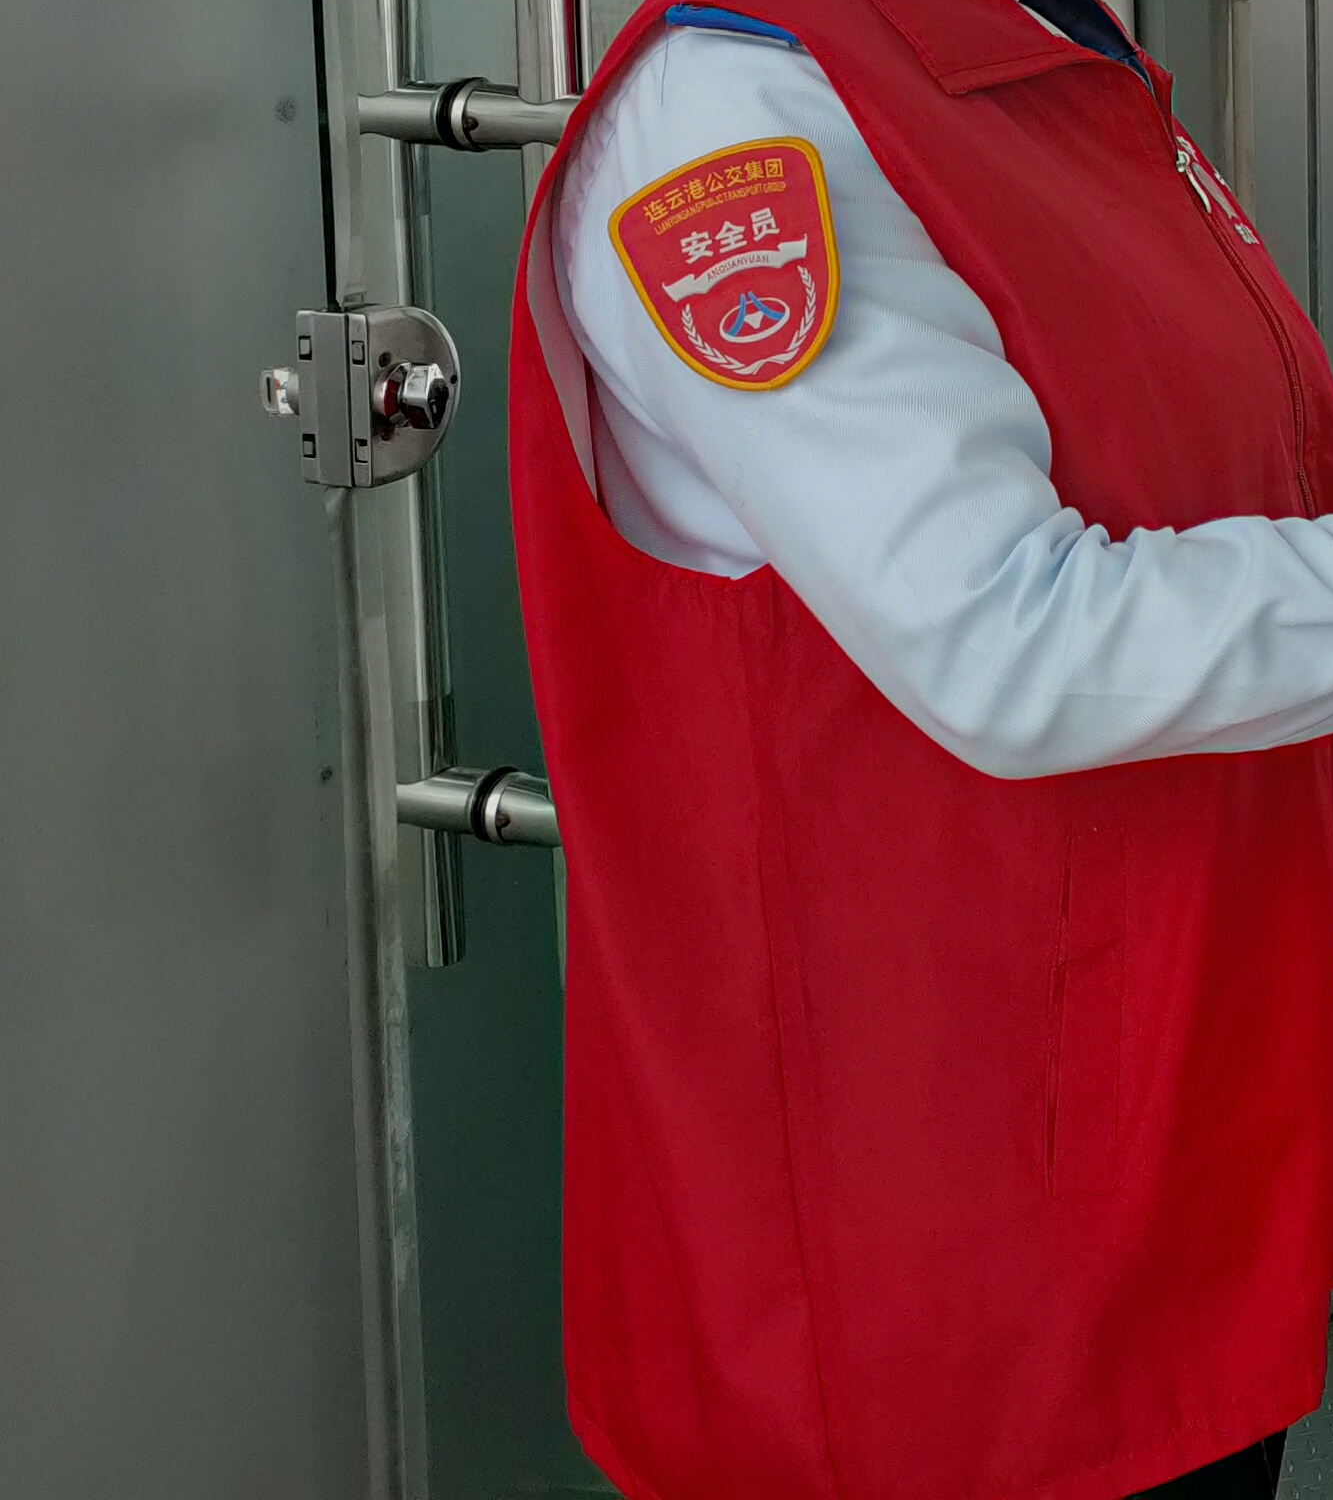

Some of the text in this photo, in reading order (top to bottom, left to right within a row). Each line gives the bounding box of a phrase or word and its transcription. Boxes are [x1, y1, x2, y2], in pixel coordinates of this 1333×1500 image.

[643, 158, 785, 223] 连云港公交集团
[680, 207, 780, 264] 安全员
